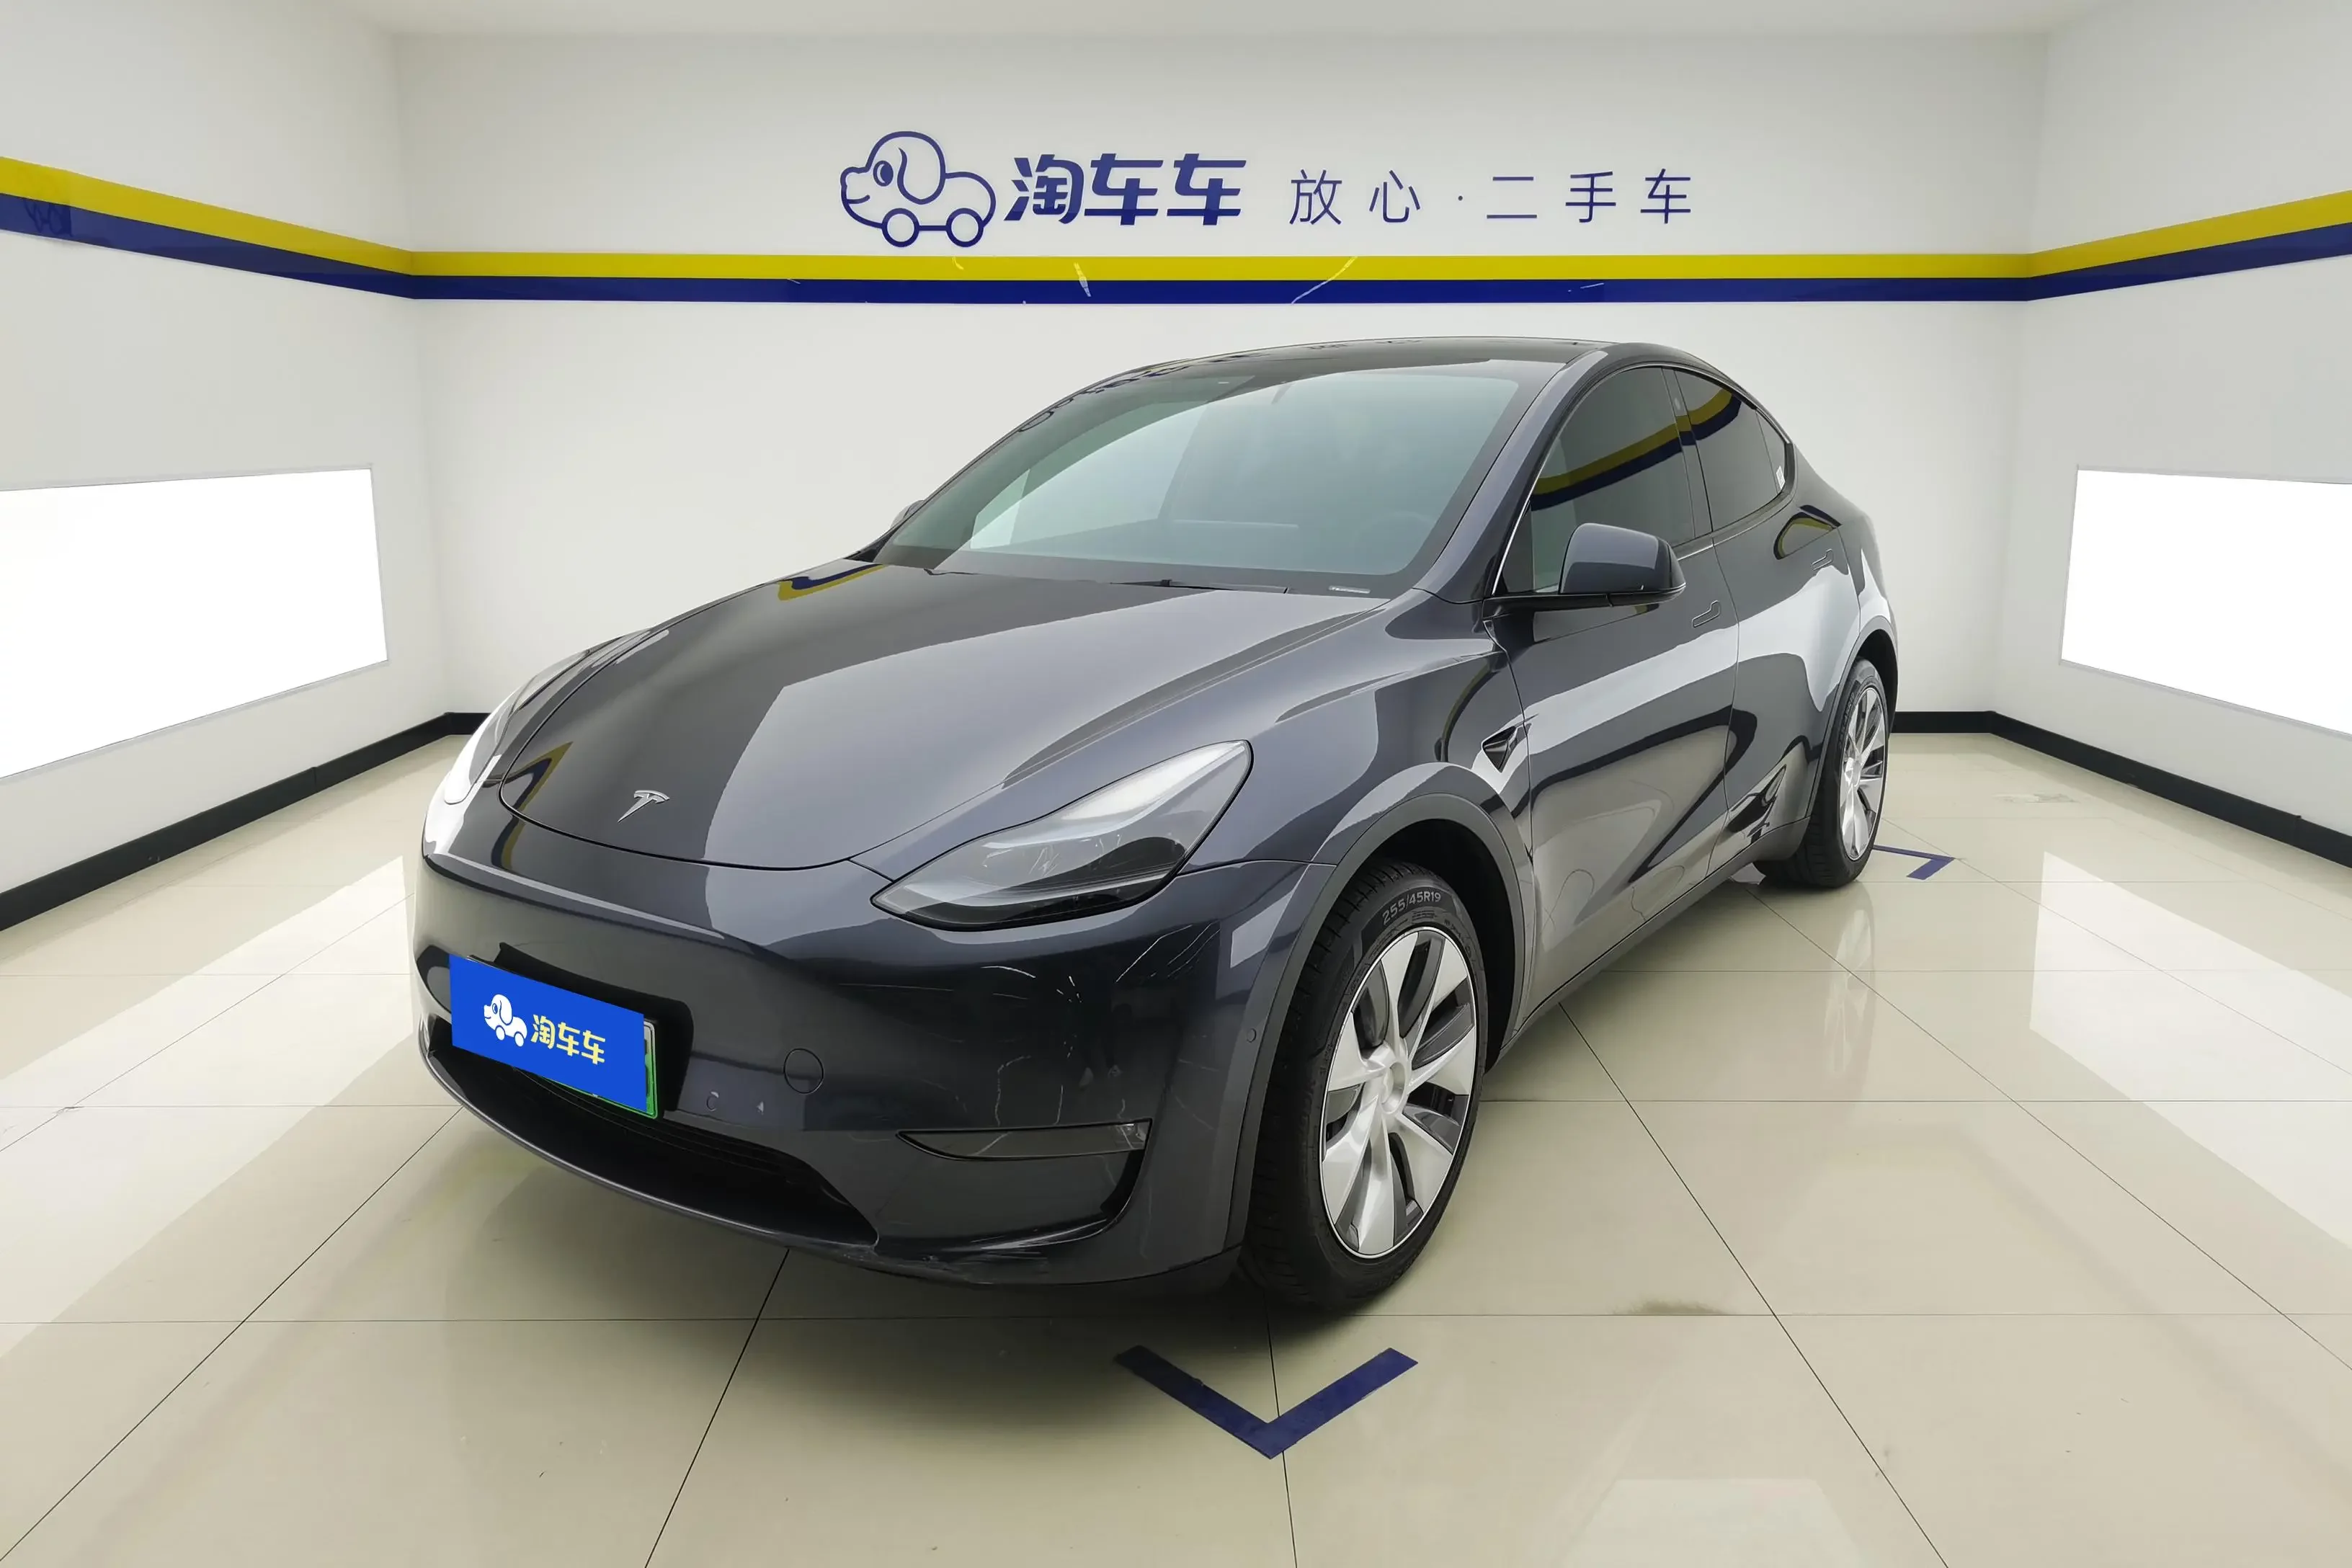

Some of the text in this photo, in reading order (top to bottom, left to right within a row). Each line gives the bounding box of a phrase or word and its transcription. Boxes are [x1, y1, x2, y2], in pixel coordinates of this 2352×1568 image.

[1005, 153, 1247, 226] 淘车车
[1382, 891, 1442, 926] 255/45R19
